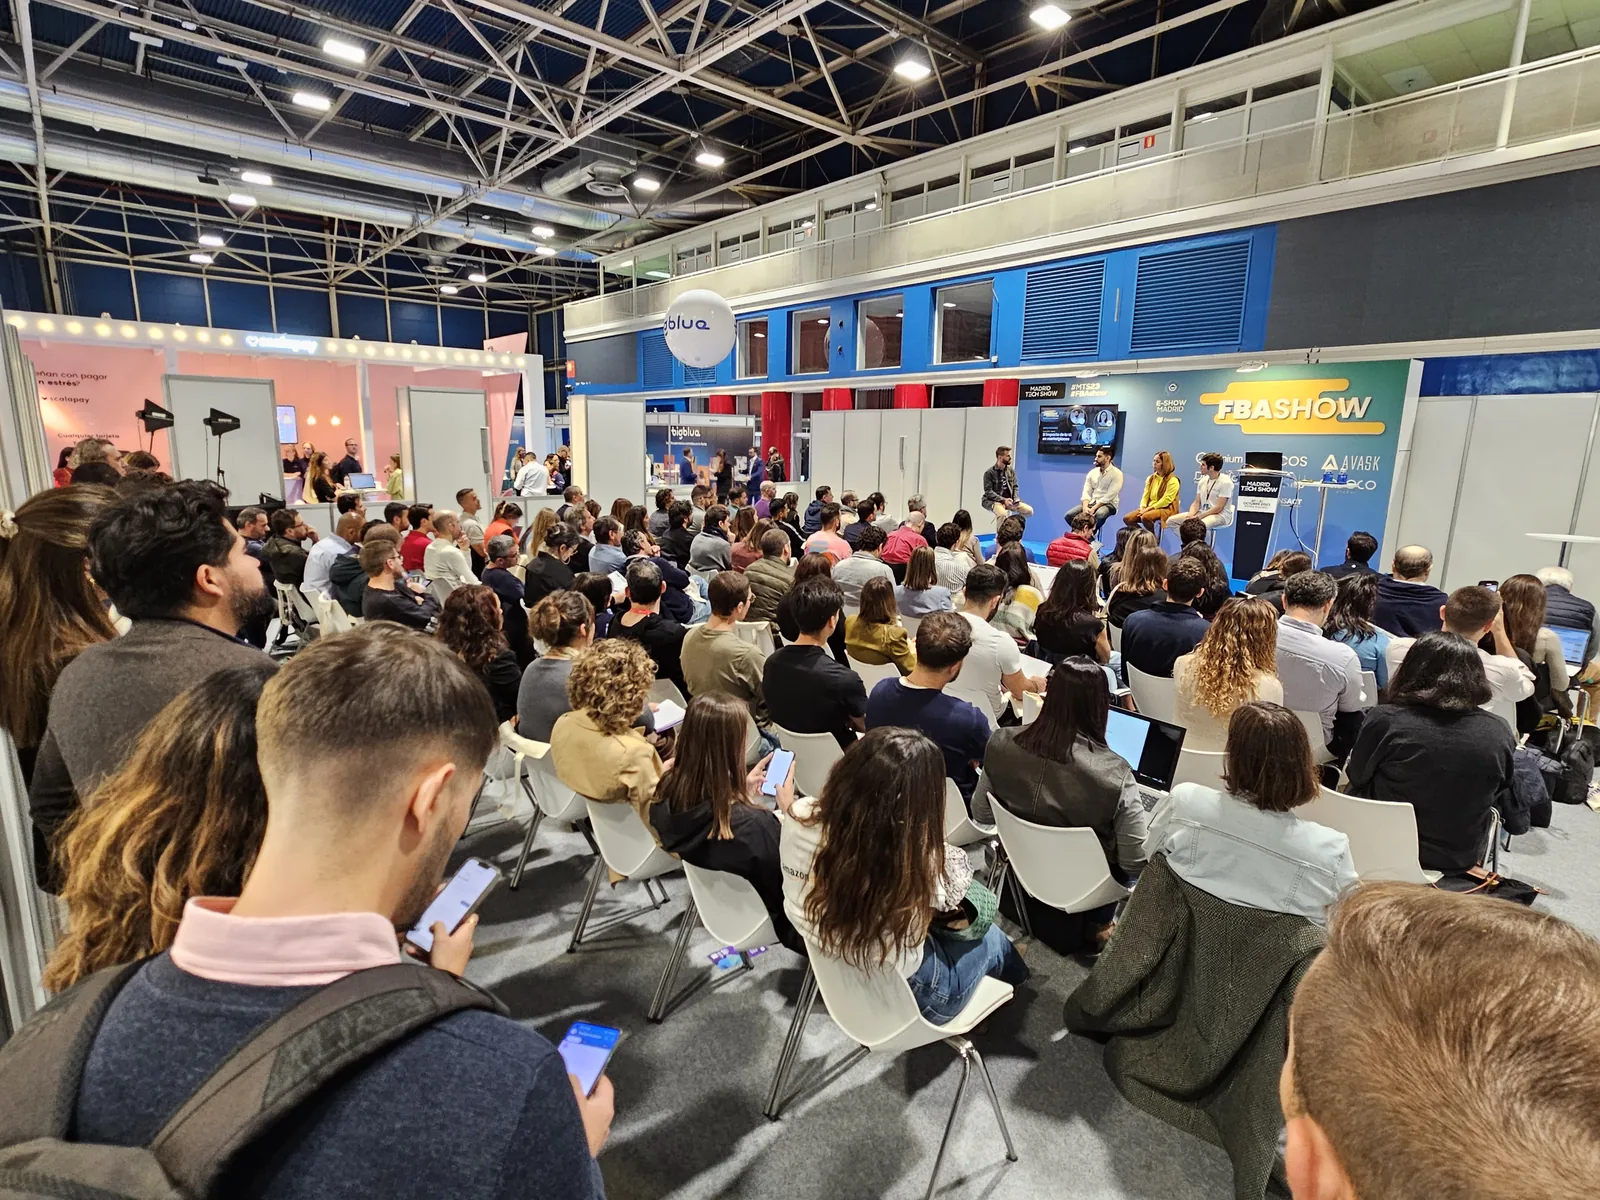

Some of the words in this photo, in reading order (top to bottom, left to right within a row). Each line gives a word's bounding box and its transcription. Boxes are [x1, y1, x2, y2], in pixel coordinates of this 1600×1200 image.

[80, 373, 108, 381] pagar
[1156, 399, 1187, 407] E-SHOW
[1217, 396, 1372, 420] FBASHOW
[671, 426, 701, 440] bigblue
[1341, 455, 1381, 472] AVASK
